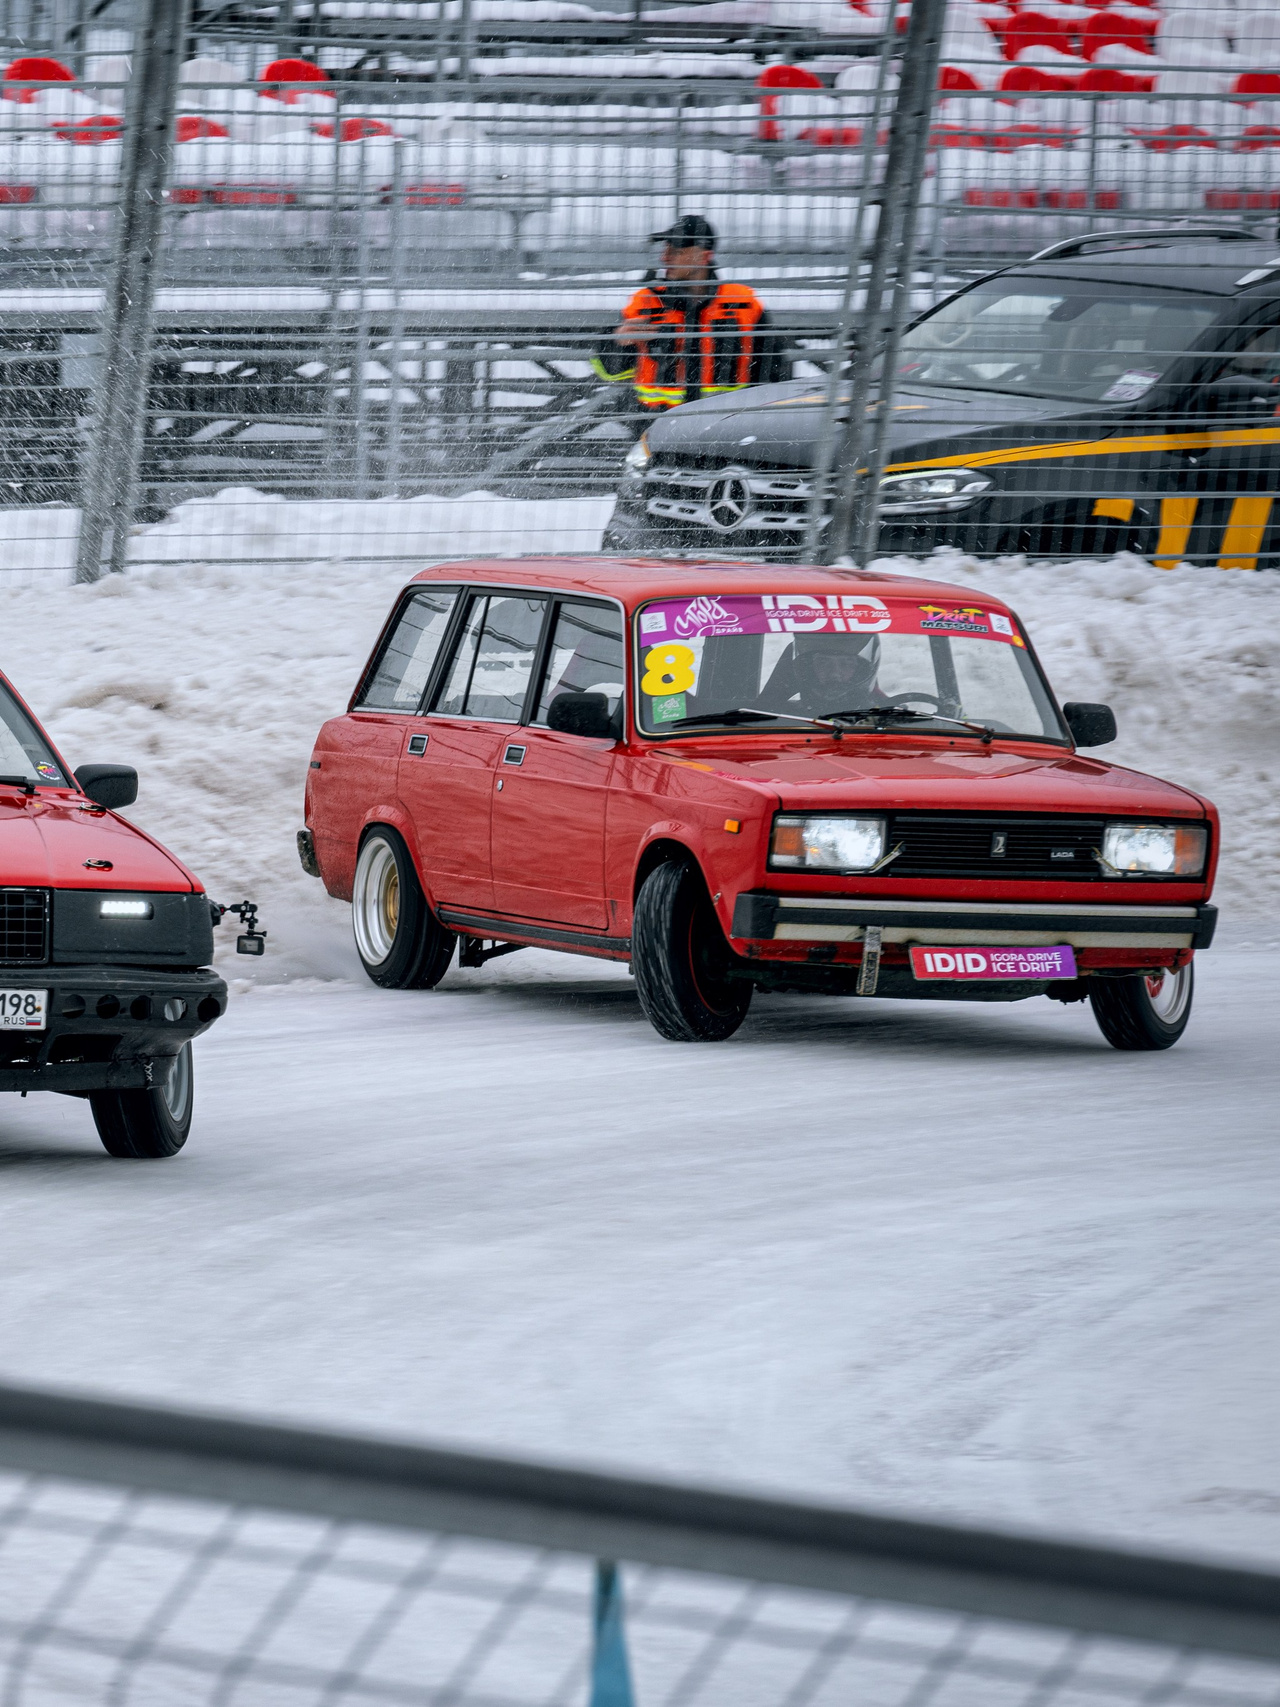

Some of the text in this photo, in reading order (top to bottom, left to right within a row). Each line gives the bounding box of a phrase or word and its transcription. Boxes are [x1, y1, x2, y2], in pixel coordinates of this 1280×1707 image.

[761, 596, 892, 632] IDID
[920, 620, 989, 633] MATSURI
[641, 644, 696, 696] 8
[923, 952, 988, 974] IDID
[990, 951, 1062, 962] IGORA DRIVE
[992, 961, 1063, 973] ICE DRIFT
[3, 1016, 26, 1026] RUS
